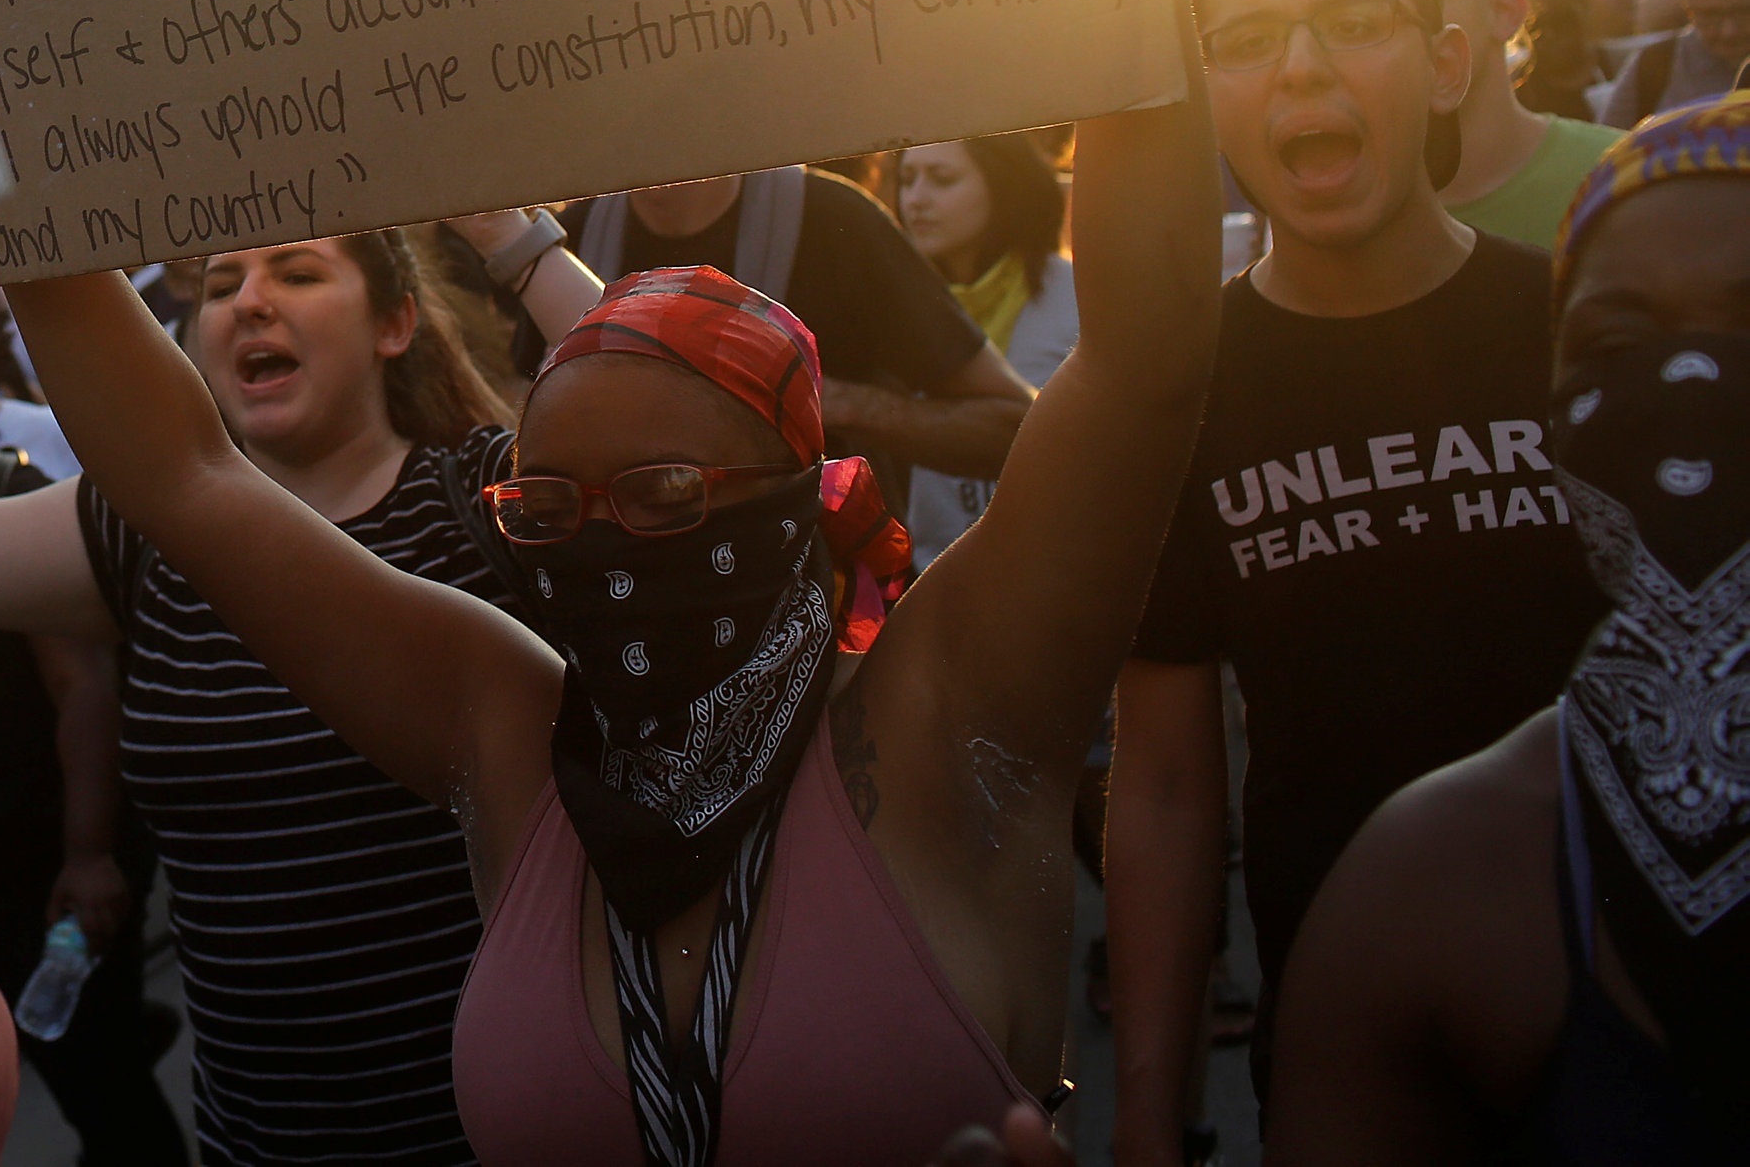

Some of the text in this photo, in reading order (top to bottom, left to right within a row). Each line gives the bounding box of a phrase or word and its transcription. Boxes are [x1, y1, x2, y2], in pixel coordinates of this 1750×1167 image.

[44, 100, 181, 179] always
[202, 69, 347, 159] uphold
[375, 52, 467, 116] the
[82, 198, 149, 262] my
[1211, 419, 1553, 527] UNLEAR
[1229, 508, 1381, 579] FEAR
[1452, 485, 1570, 533] HAT
